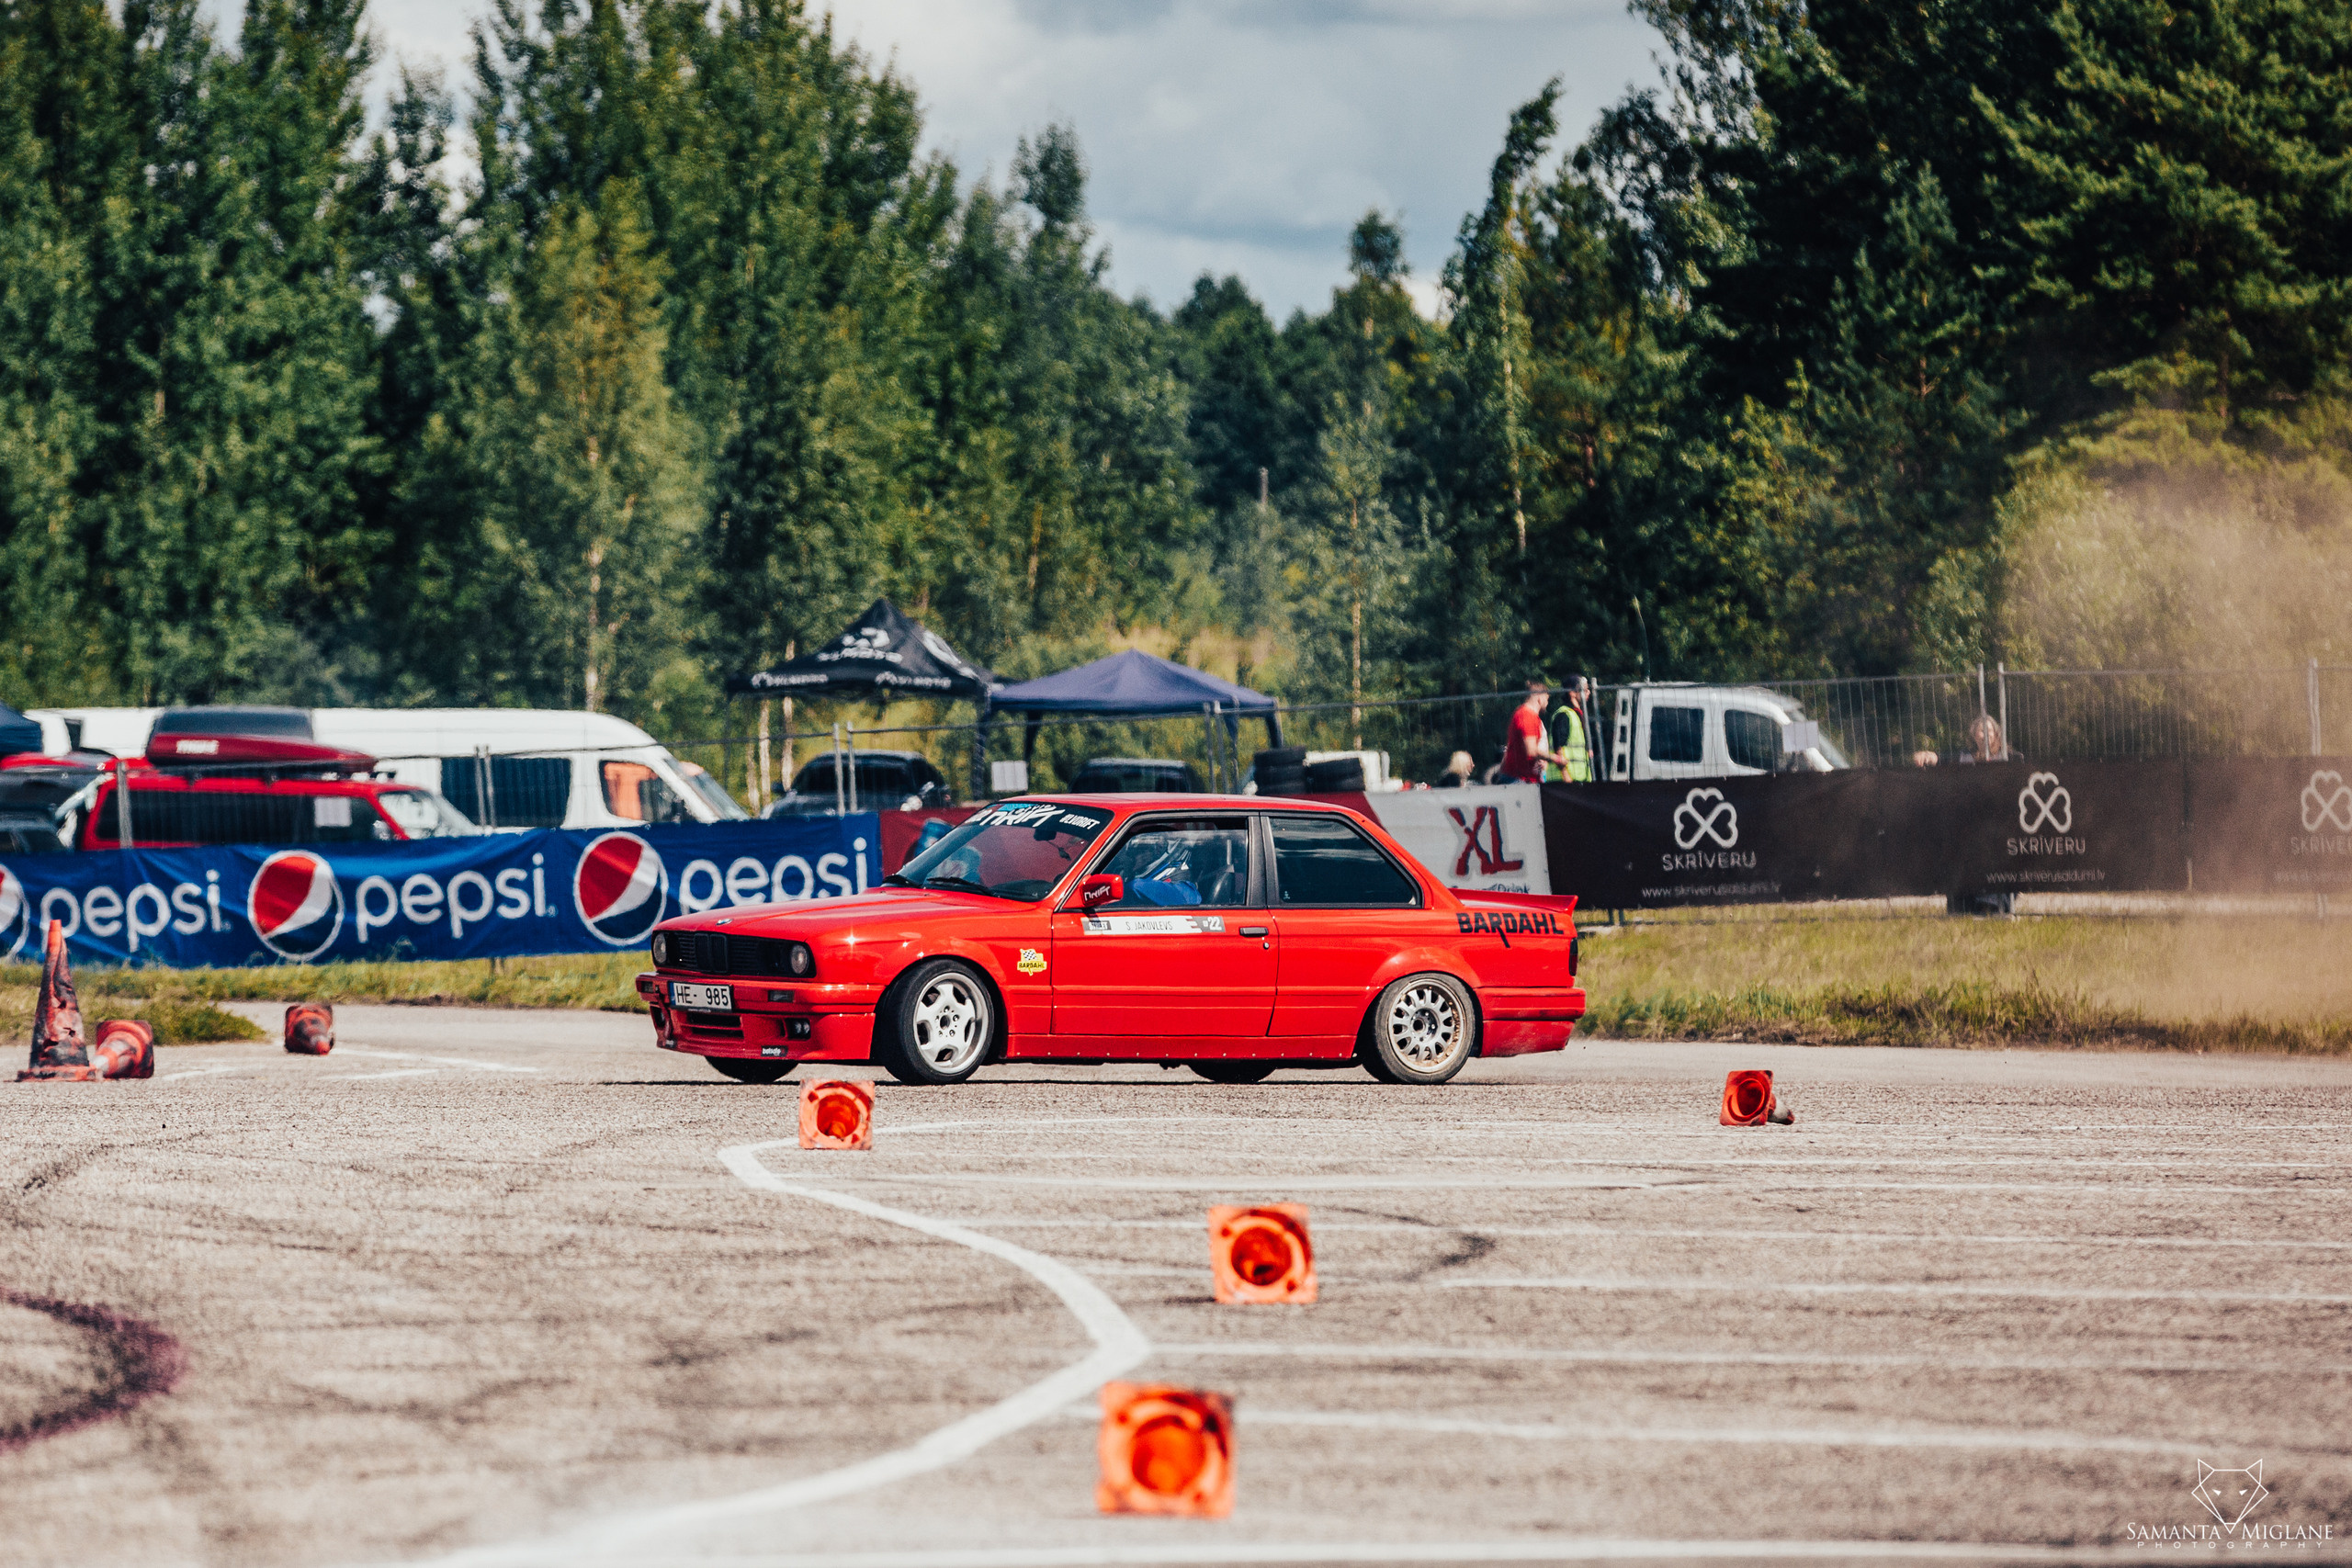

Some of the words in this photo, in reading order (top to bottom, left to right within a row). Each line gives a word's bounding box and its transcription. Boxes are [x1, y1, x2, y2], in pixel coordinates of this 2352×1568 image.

[1448, 806, 1524, 876] XL
[40, 869, 221, 953] pepsi
[356, 852, 547, 943] pepsi
[679, 837, 868, 916] pepsi
[1134, 920, 1173, 931] JAKOVLEVS
[1456, 913, 1564, 948] BARDAHL
[706, 987, 729, 1007] 985
